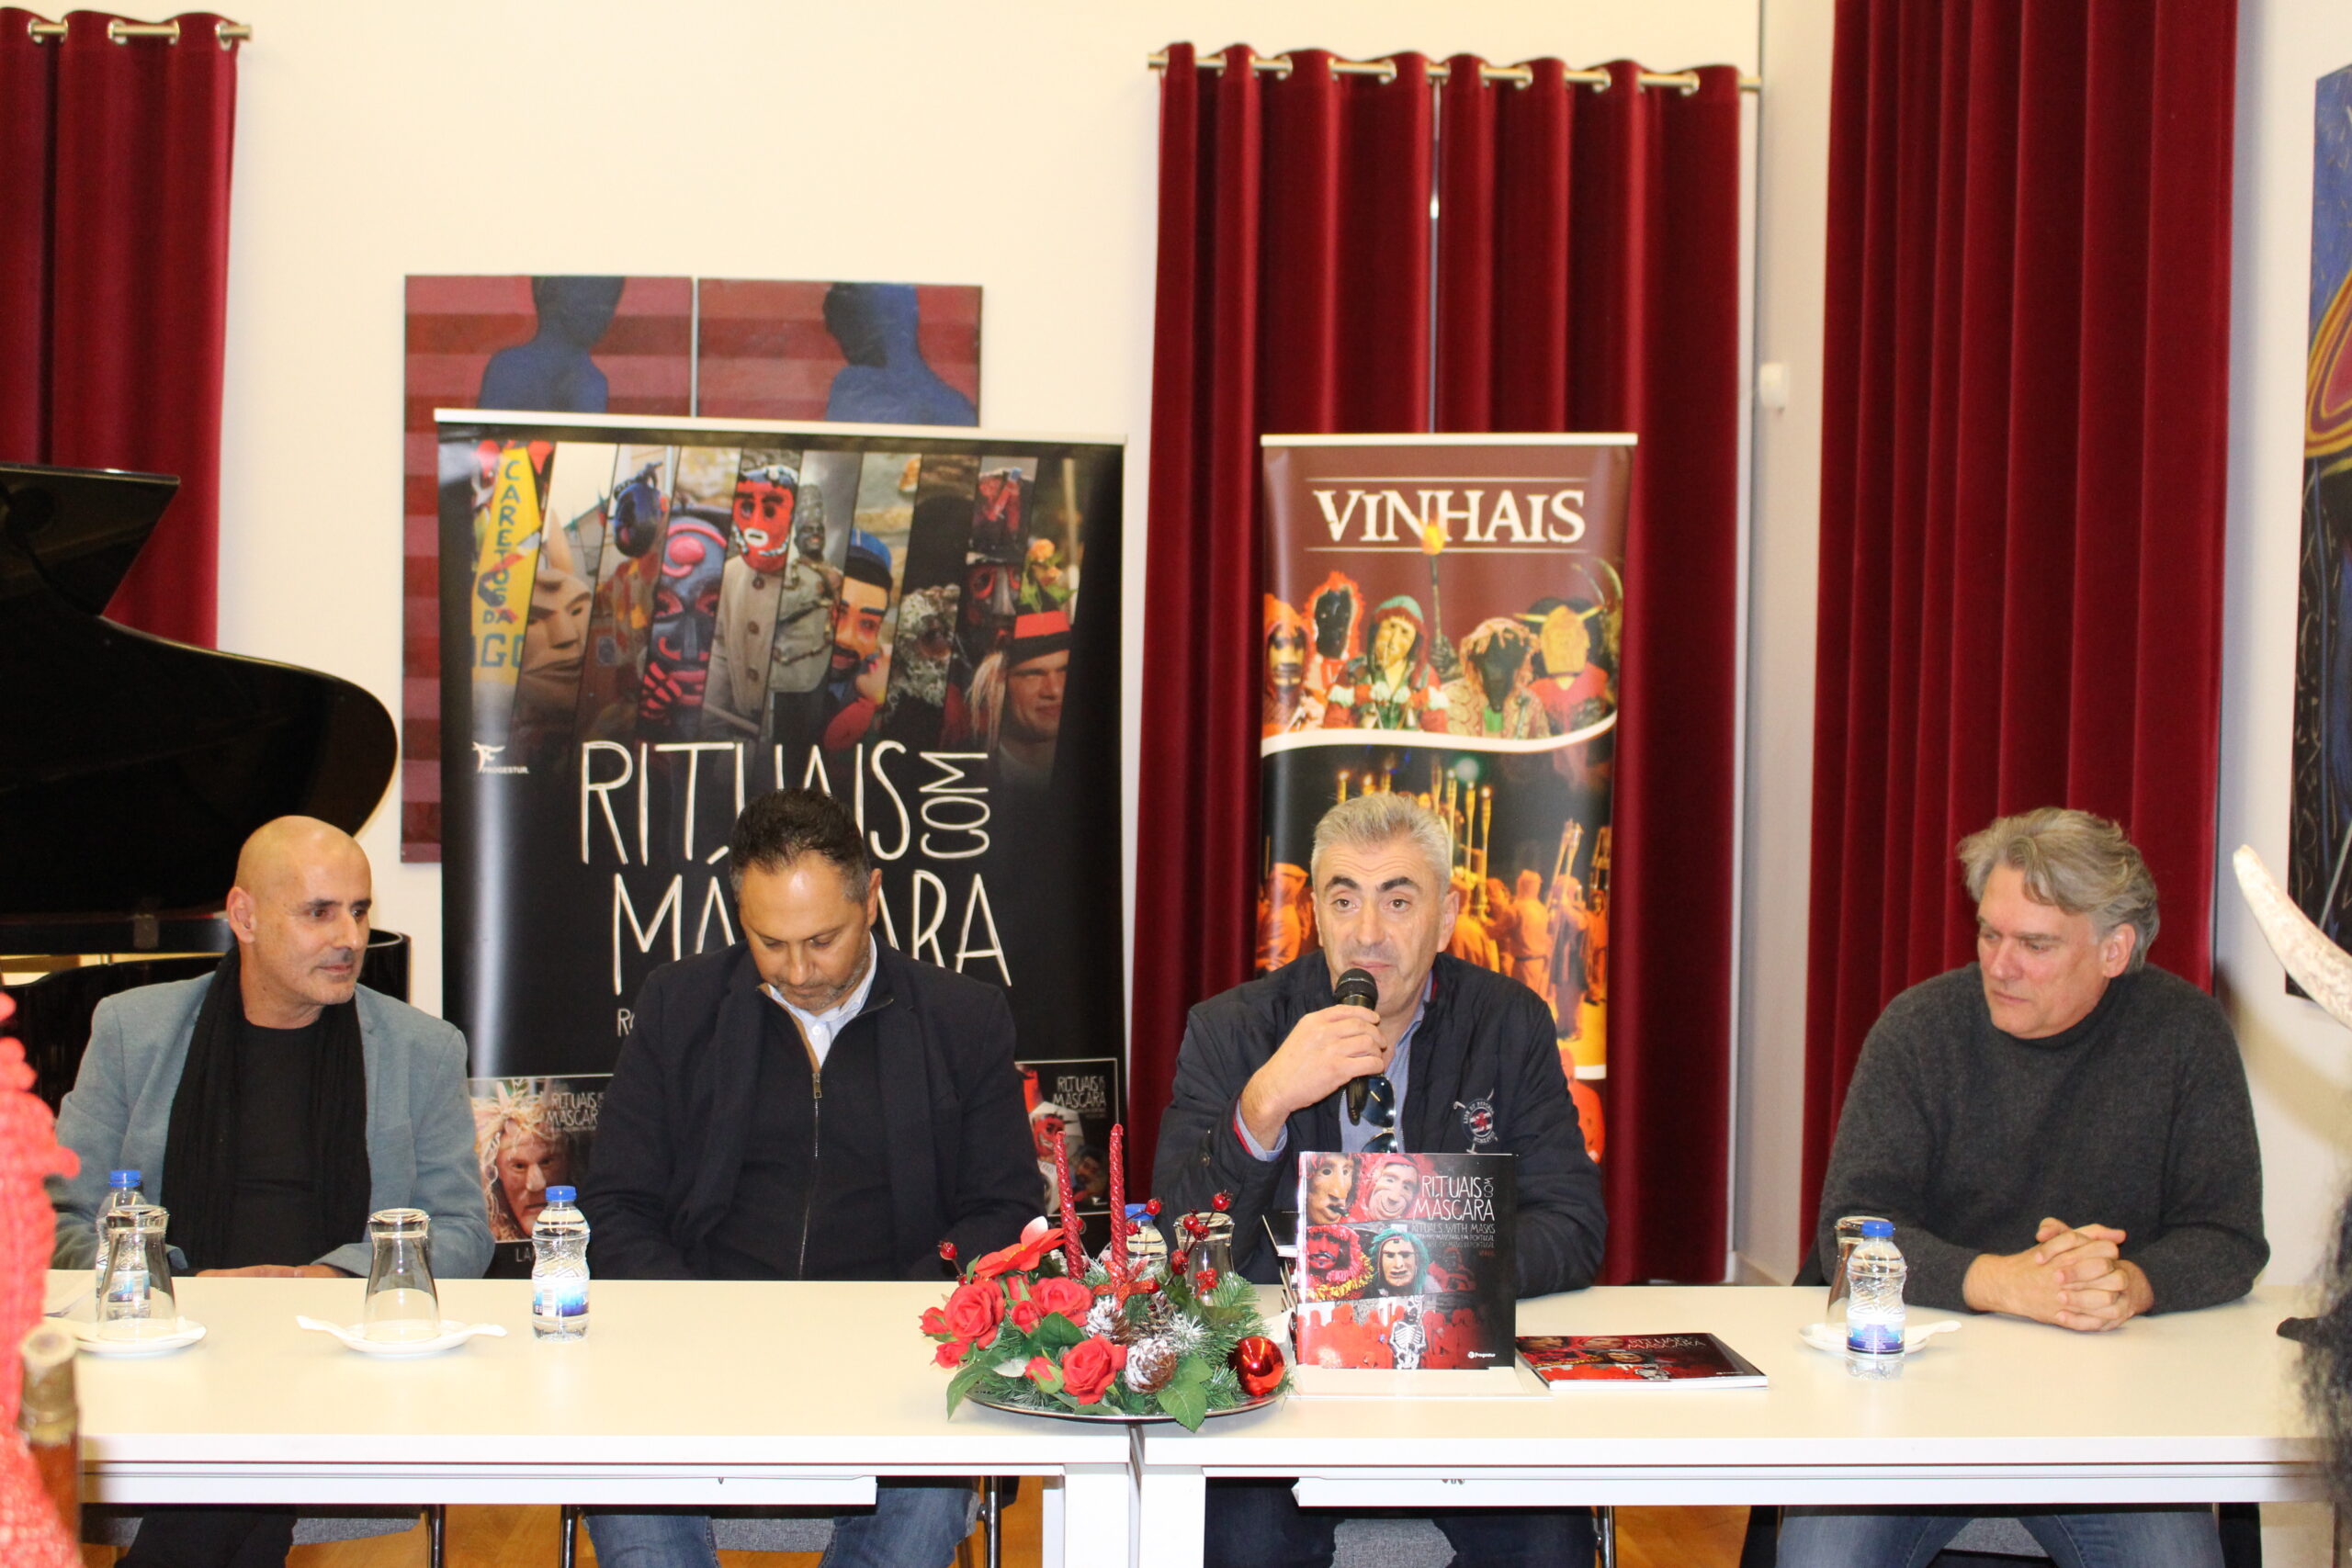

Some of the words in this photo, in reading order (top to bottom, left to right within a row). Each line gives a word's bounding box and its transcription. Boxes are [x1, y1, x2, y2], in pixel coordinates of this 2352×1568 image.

[1313, 490, 1586, 544] VINHAIS
[920, 751, 990, 859] COM
[613, 845, 1012, 996] MÁRA
[1057, 1076, 1099, 1092] RITUAIS
[551, 1091, 598, 1110] RITUAIS
[547, 1108, 599, 1126] MÁSCAR
[1421, 1175, 1482, 1198] RITUAIS
[1413, 1195, 1495, 1221] MÁSCARA
[1444, 1224, 1468, 1234] WITH
[1470, 1223, 1496, 1234] MASKS
